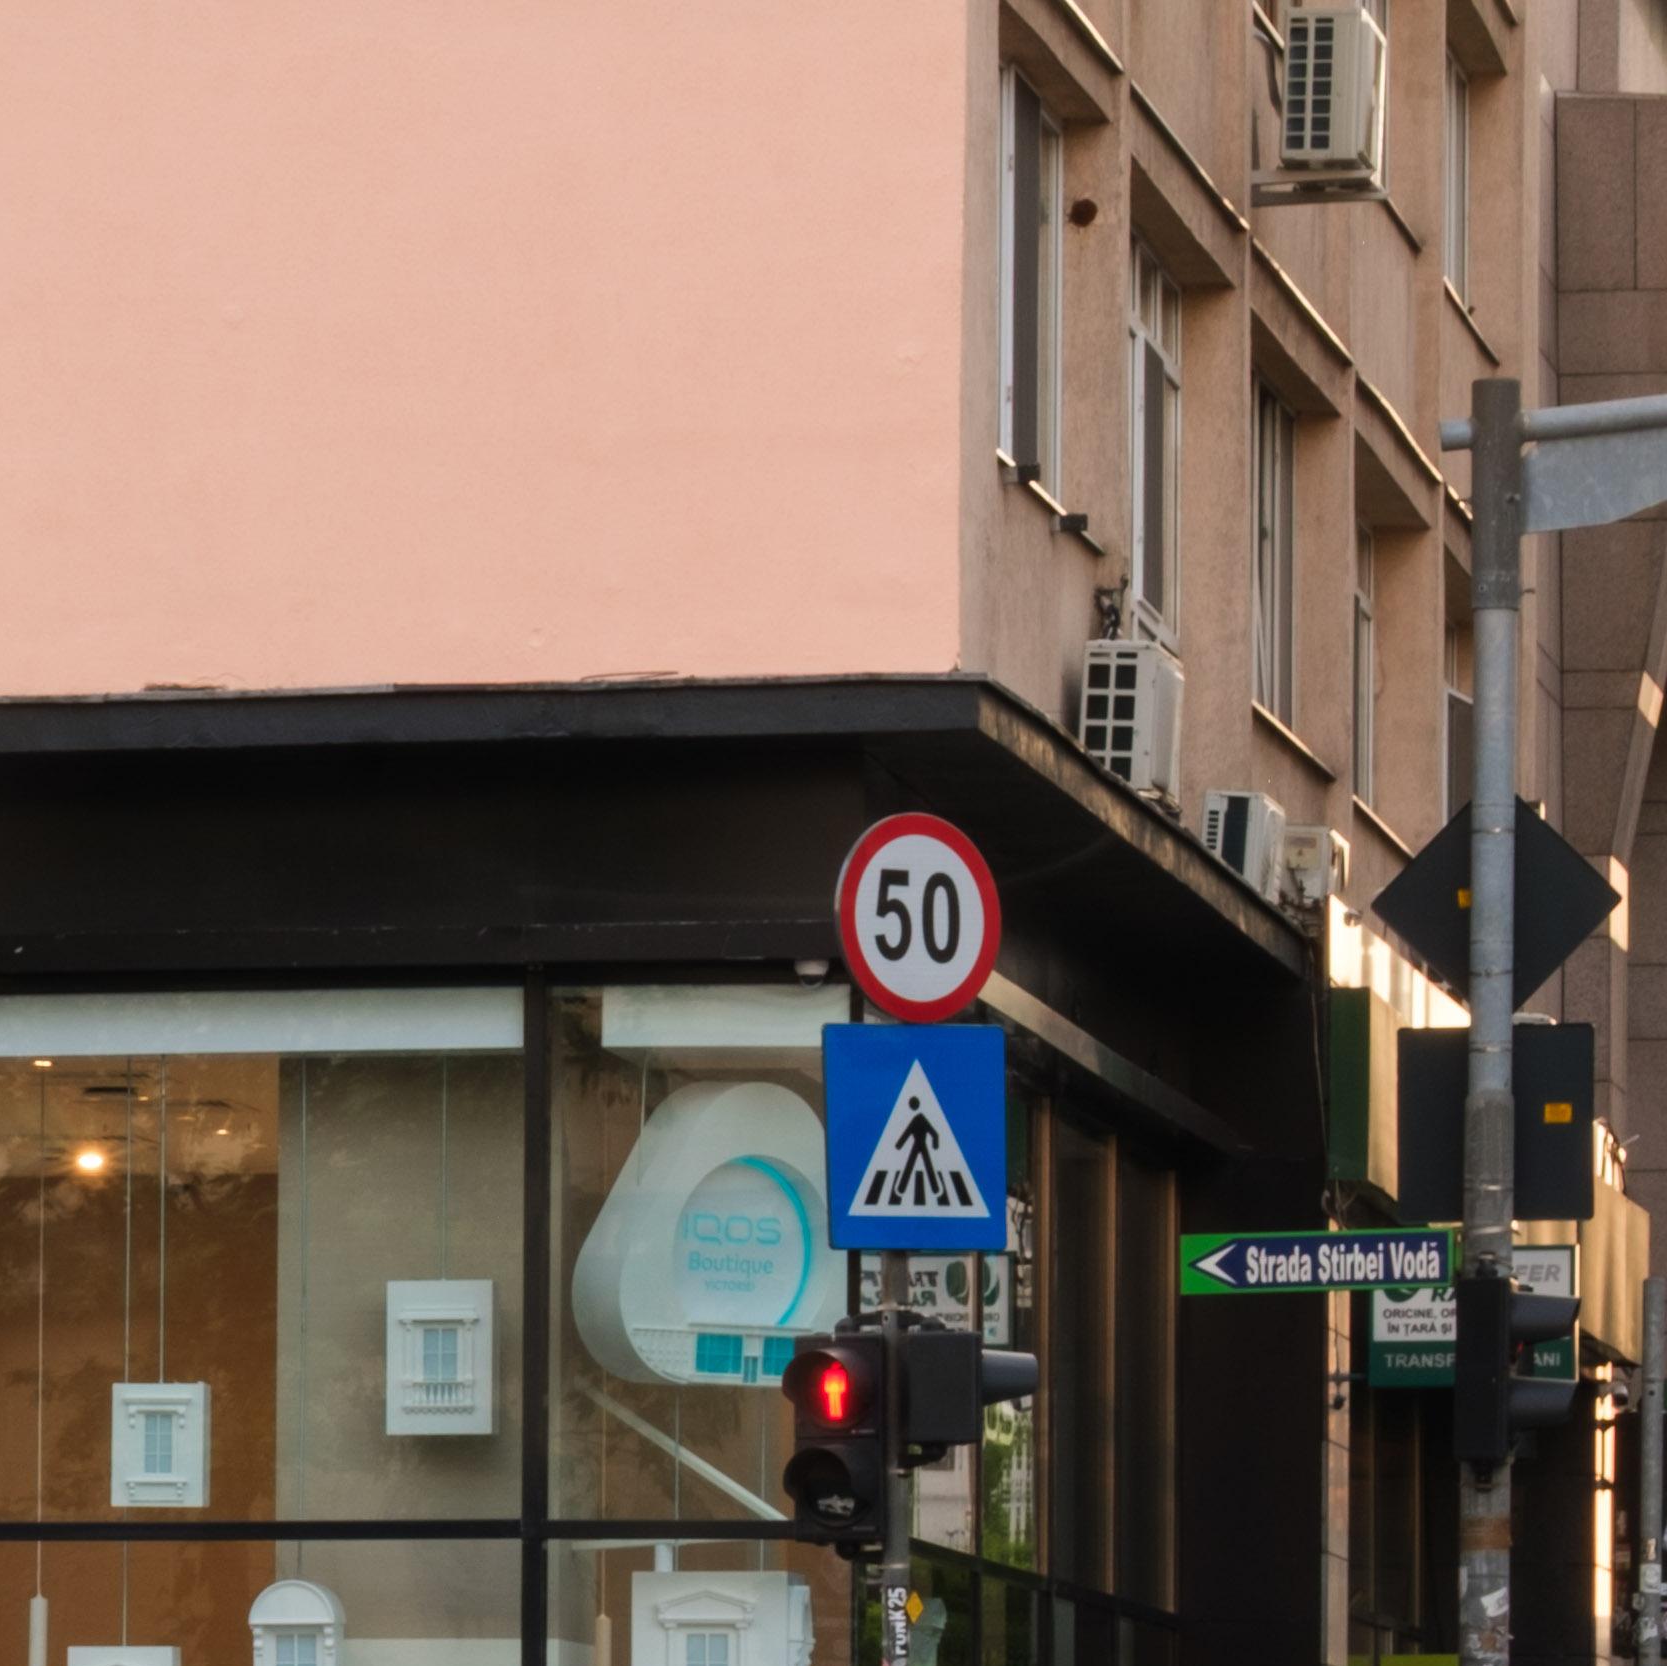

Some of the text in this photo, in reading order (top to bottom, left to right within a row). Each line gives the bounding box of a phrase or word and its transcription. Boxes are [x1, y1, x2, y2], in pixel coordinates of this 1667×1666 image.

[874, 868, 961, 964] 50
[683, 1214, 781, 1246] IQOS
[689, 1252, 773, 1279] Boutique
[1246, 1245, 1312, 1284] Strada
[1389, 1241, 1440, 1280] Vodă
[1384, 1352, 1561, 1369] TRANSF ANI
